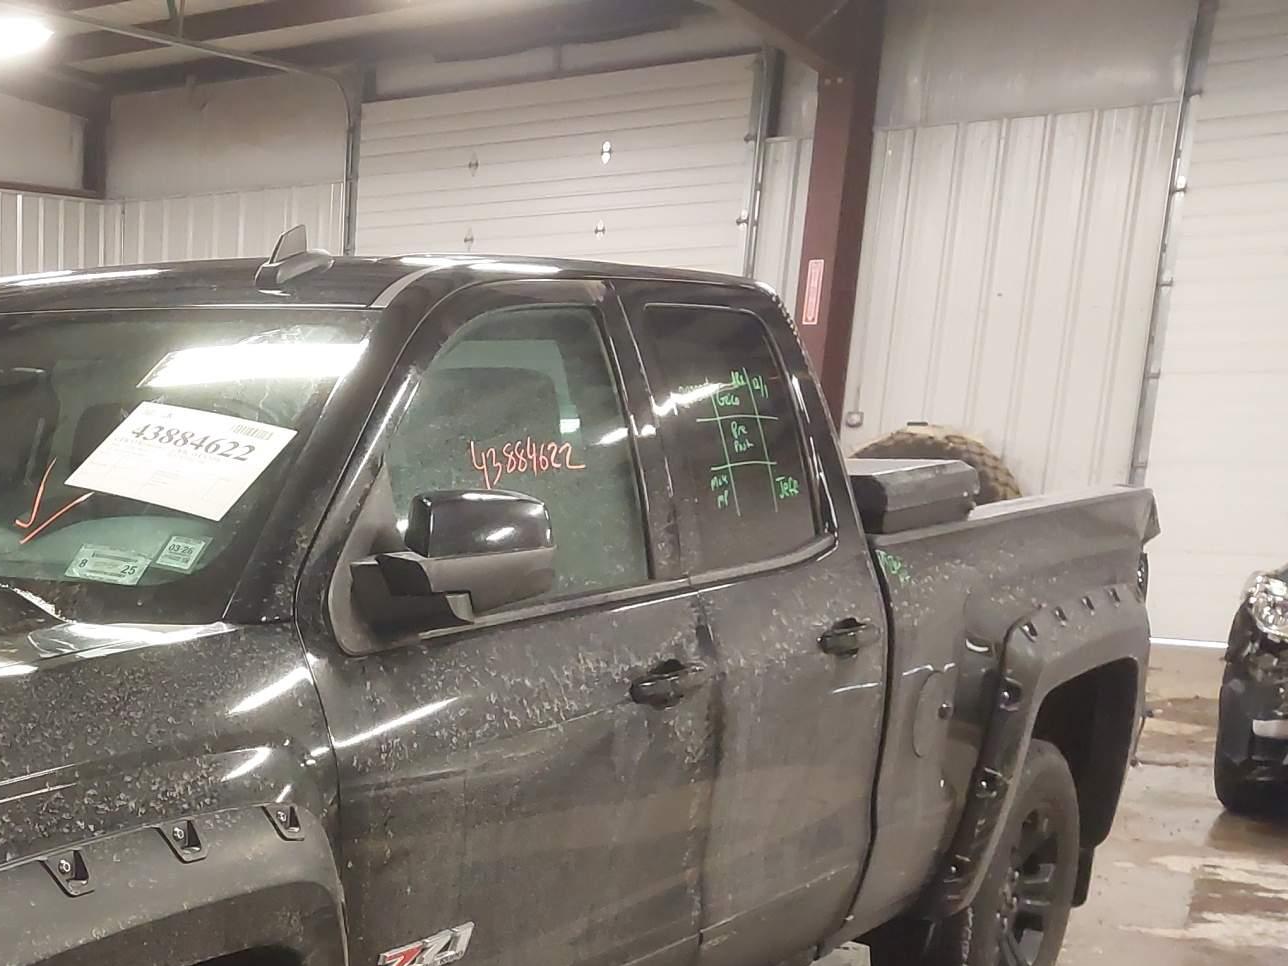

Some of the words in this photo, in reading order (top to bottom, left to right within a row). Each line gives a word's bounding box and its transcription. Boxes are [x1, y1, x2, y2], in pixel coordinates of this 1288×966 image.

[132, 423, 256, 461] 43884622
[471, 436, 586, 489] 43884622
[78, 558, 88, 568] 8
[121, 564, 138, 576] 25
